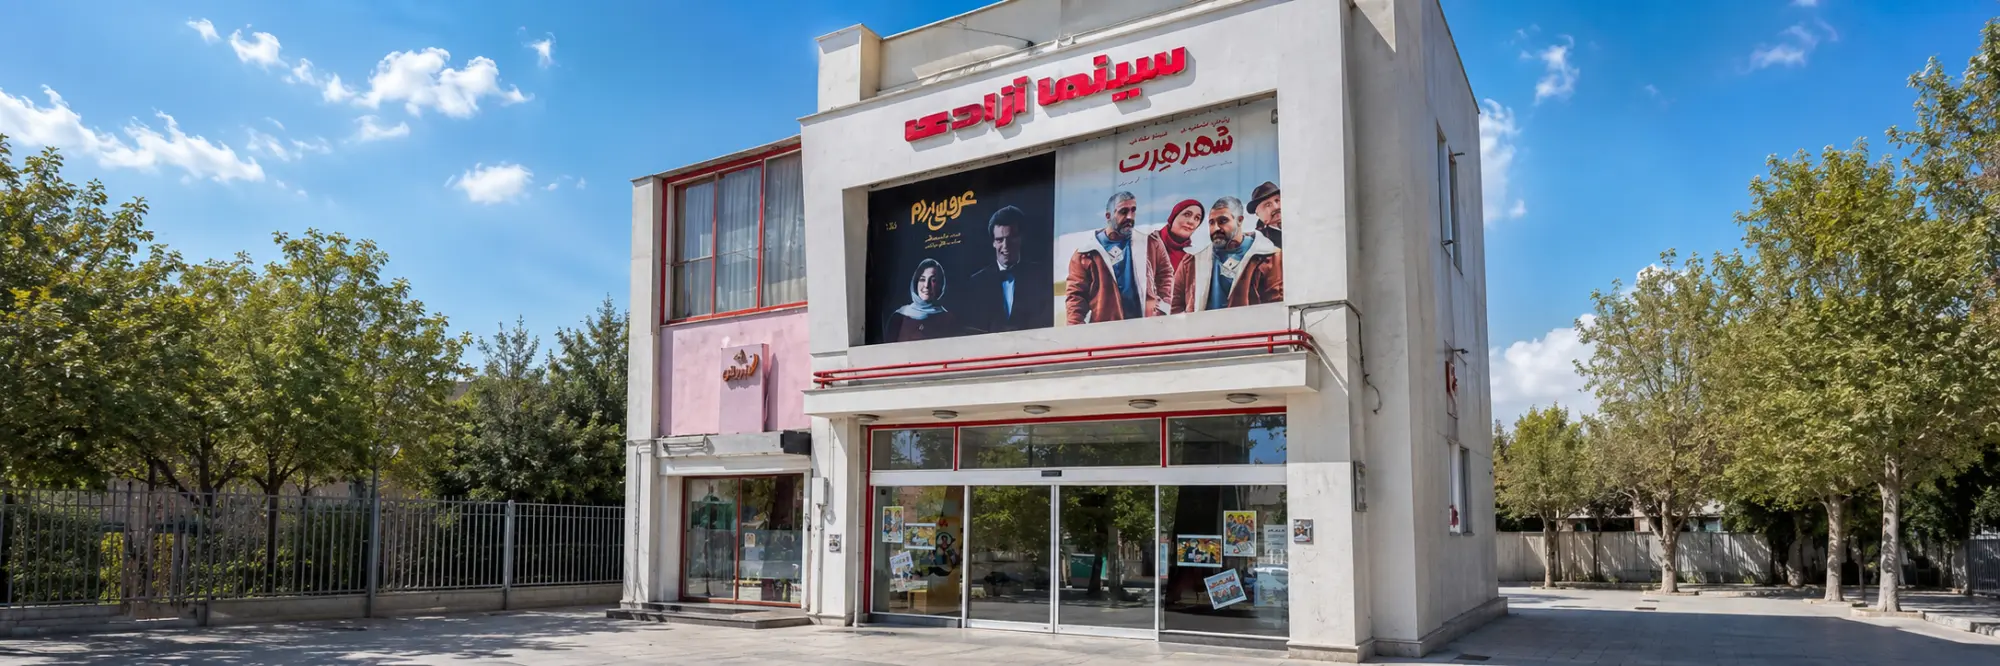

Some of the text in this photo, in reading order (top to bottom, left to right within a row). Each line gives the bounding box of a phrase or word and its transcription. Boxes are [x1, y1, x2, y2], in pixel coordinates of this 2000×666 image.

[904, 46, 1187, 142] سینما آزادی
[1180, 125, 1234, 165] شهر
